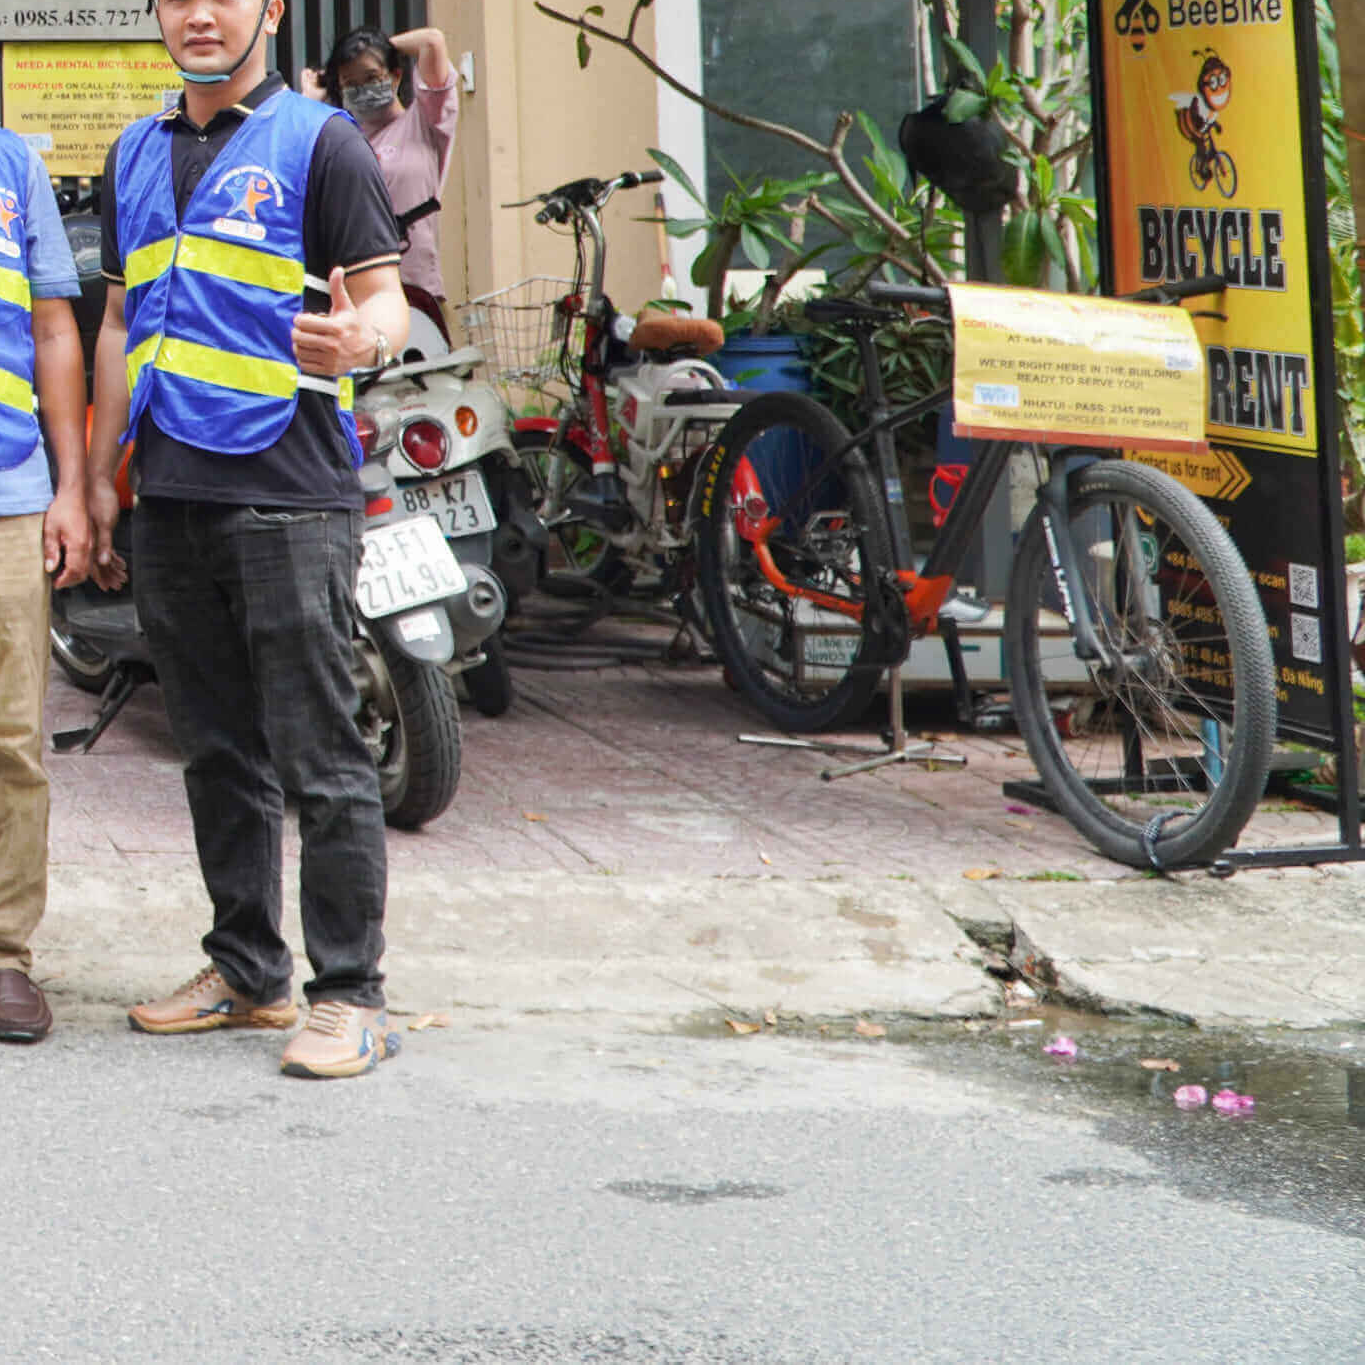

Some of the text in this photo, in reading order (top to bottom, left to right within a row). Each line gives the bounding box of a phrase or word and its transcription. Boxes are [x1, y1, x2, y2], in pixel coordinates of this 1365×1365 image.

[14, 10, 141, 27] 0985.455.727
[16, 60, 44, 70] NEED
[45, 60, 53, 69] A
[56, 60, 94, 69] RENTAL
[98, 60, 148, 70] BICYCLES
[52, 82, 63, 90] US
[65, 82, 79, 90] ON
[51, 113, 77, 121] RIGHT
[80, 113, 104, 121] HERE
[50, 123, 80, 131] READY
[1137, 205, 1287, 293] BICYCLE
[979, 358, 1182, 380] WE'RE RIGHT HERE IN THE BUILDING
[1017, 373, 1056, 385] READY
[1060, 375, 1074, 386] TO
[1077, 377, 1114, 389] SERVE
[1206, 345, 1309, 437] RENT
[1023, 399, 1066, 410] NHATUI
[1171, 461, 1181, 475] us
[1184, 460, 1199, 478] for
[1201, 466, 1221, 483] rent
[403, 478, 466, 513] 88-K7
[1259, 573, 1286, 589] scan
